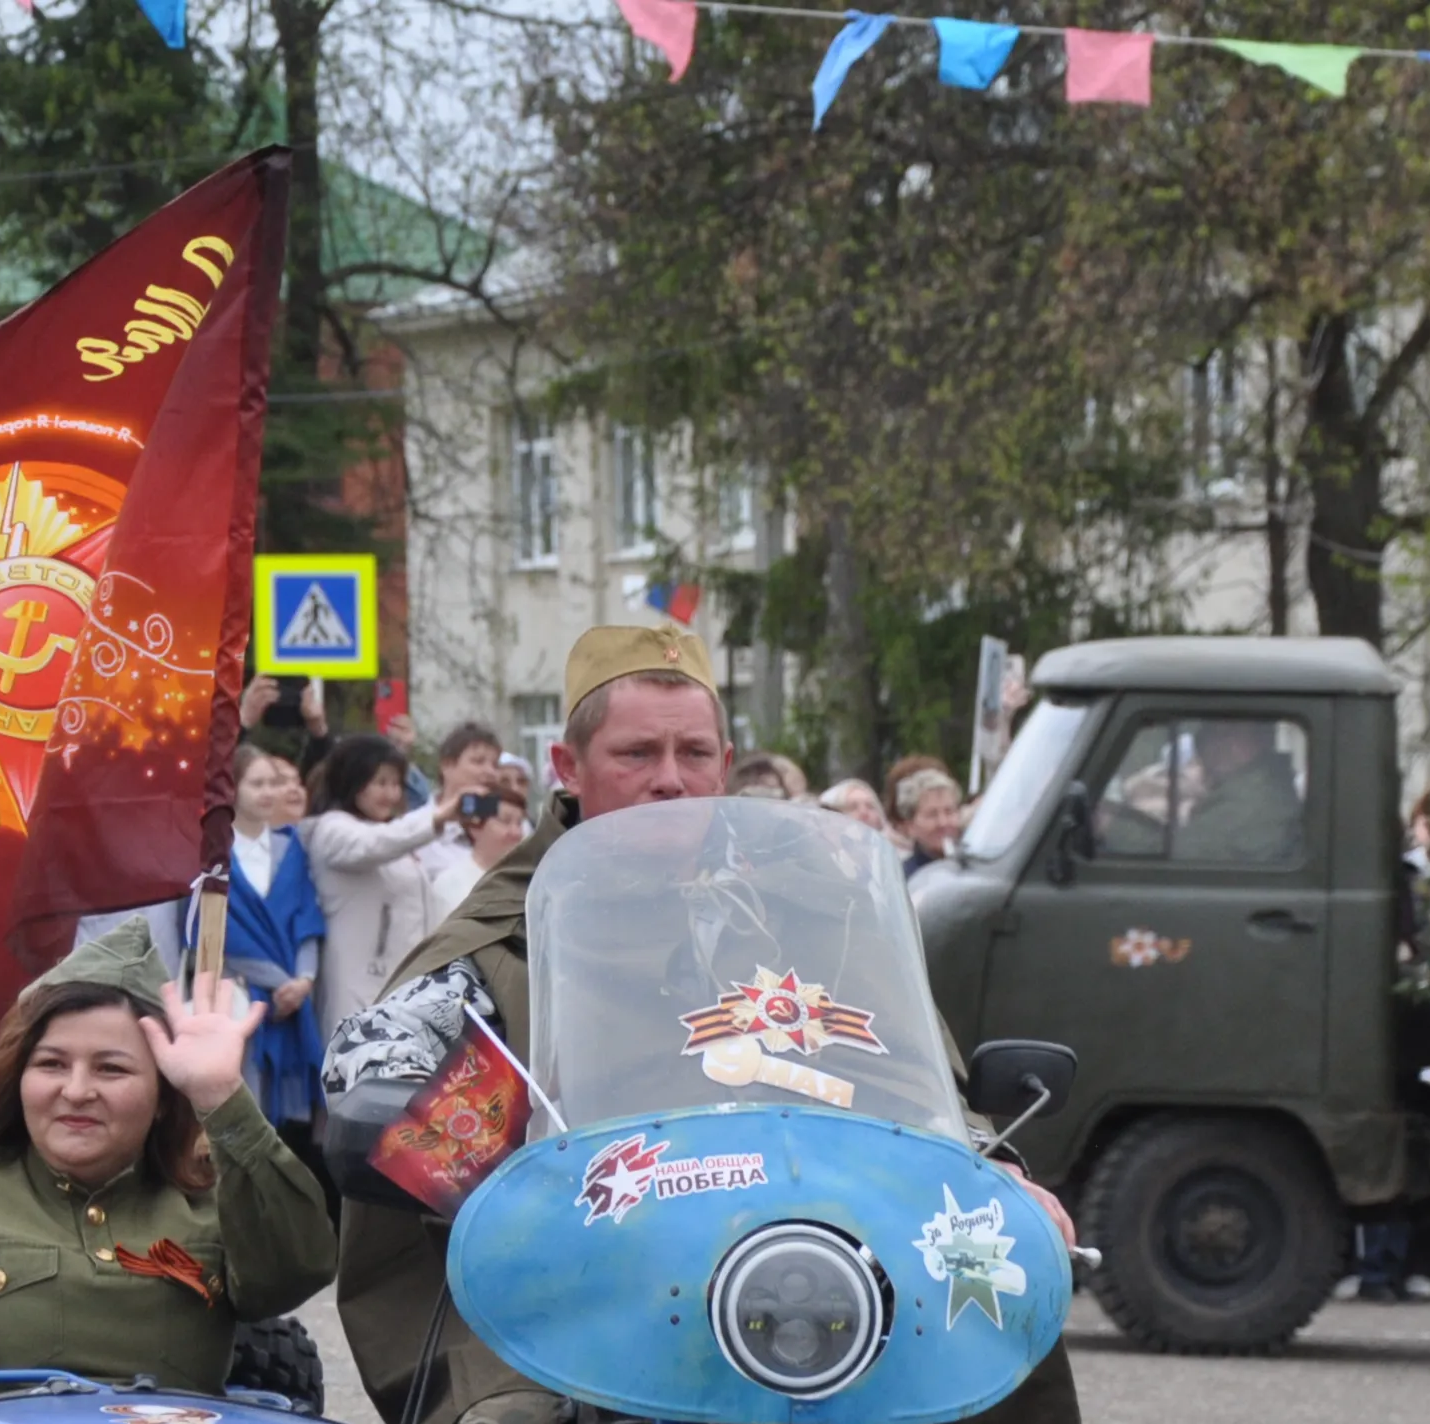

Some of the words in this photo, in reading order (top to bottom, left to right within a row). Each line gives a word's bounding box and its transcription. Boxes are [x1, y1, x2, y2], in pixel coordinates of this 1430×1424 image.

[655, 1160, 699, 1177] НАША
[705, 1155, 762, 1170] ОБЩАЯ
[657, 1168, 765, 1198] ПОБЕДА
[950, 1203, 999, 1236] Родину!
